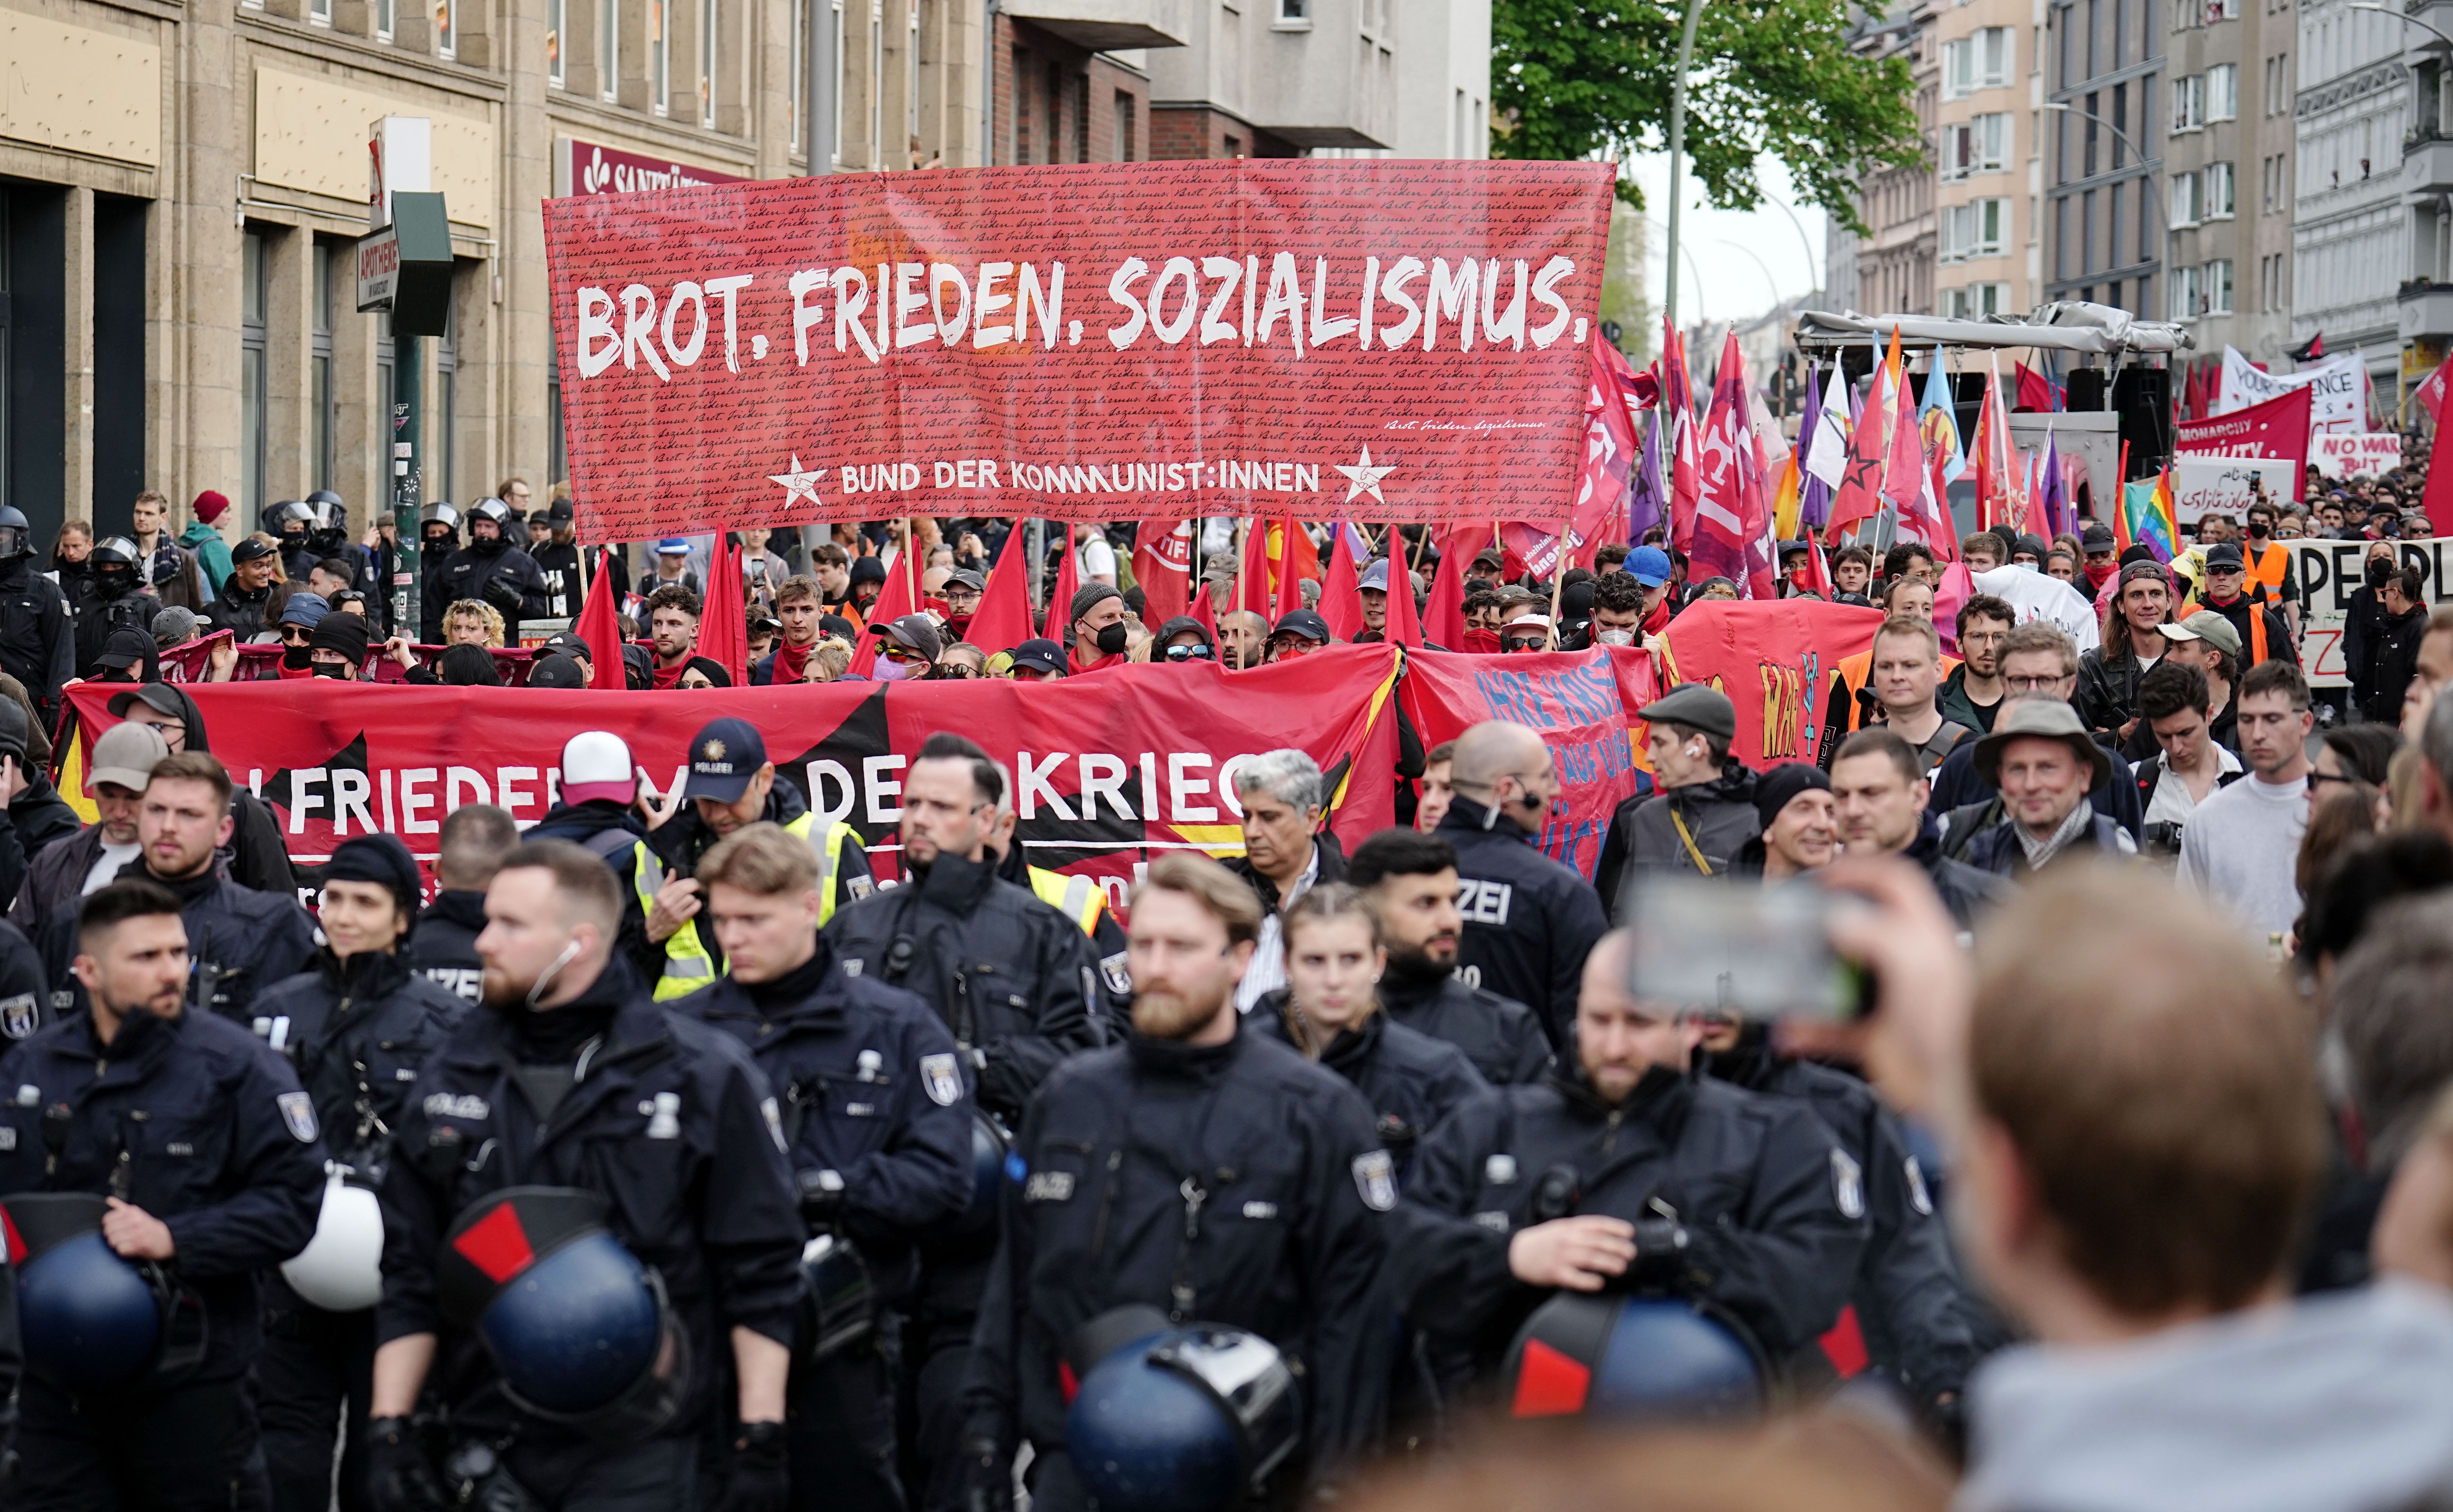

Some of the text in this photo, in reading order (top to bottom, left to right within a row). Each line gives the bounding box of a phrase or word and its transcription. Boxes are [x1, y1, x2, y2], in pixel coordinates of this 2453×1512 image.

[629, 192, 659, 202] Brot.
[786, 179, 816, 189] Brot.
[943, 170, 973, 179] Brot.
[1099, 164, 1130, 173] Brot.
[1260, 160, 1294, 169] Brot.
[666, 202, 697, 211] Brot.
[825, 188, 855, 198] Brot.
[980, 181, 1011, 190] Brot.
[1136, 176, 1168, 185] Brot.
[1300, 173, 1333, 182] Brot.
[552, 224, 580, 233] Brot.
[704, 211, 735, 221] Brot.
[863, 197, 893, 207] Brot.
[1016, 192, 1047, 202] Brot.
[1174, 187, 1206, 197] Brot.
[1340, 187, 1374, 196] Brot.
[360, 239, 397, 281] APOTHEKE
[577, 251, 1587, 382] BROT. FRIEDEN. SOZIALISMUS.
[1033, 358, 1063, 367] Brot.
[1190, 354, 1222, 363] Brot.
[1352, 356, 1386, 365] Brot.
[580, 384, 610, 393] Brot.
[734, 371, 765, 381] Brot.
[1107, 381, 1138, 391] Brot.
[1265, 379, 1298, 389] Brot.
[2236, 365, 2271, 394] YOUR
[1146, 393, 1177, 402] Brot.
[1303, 393, 1336, 403] Brot.
[579, 433, 608, 443] Brot.
[733, 421, 763, 432] Brot.
[1383, 420, 1420, 430] Brot.
[615, 443, 646, 453] Brot.
[769, 431, 799, 441] Brot.
[2323, 436, 2400, 455] NO WAR
[841, 463, 920, 495] BUND
[935, 459, 999, 489] DER
[2338, 458, 2381, 479] BUT
[573, 483, 603, 493] Brot.
[2301, 543, 2453, 611] PEPL
[1474, 670, 1557, 728] IHRE
[695, 761, 733, 774] POLIZEI
[1561, 743, 1597, 785] AUF
[807, 754, 906, 823] DE
